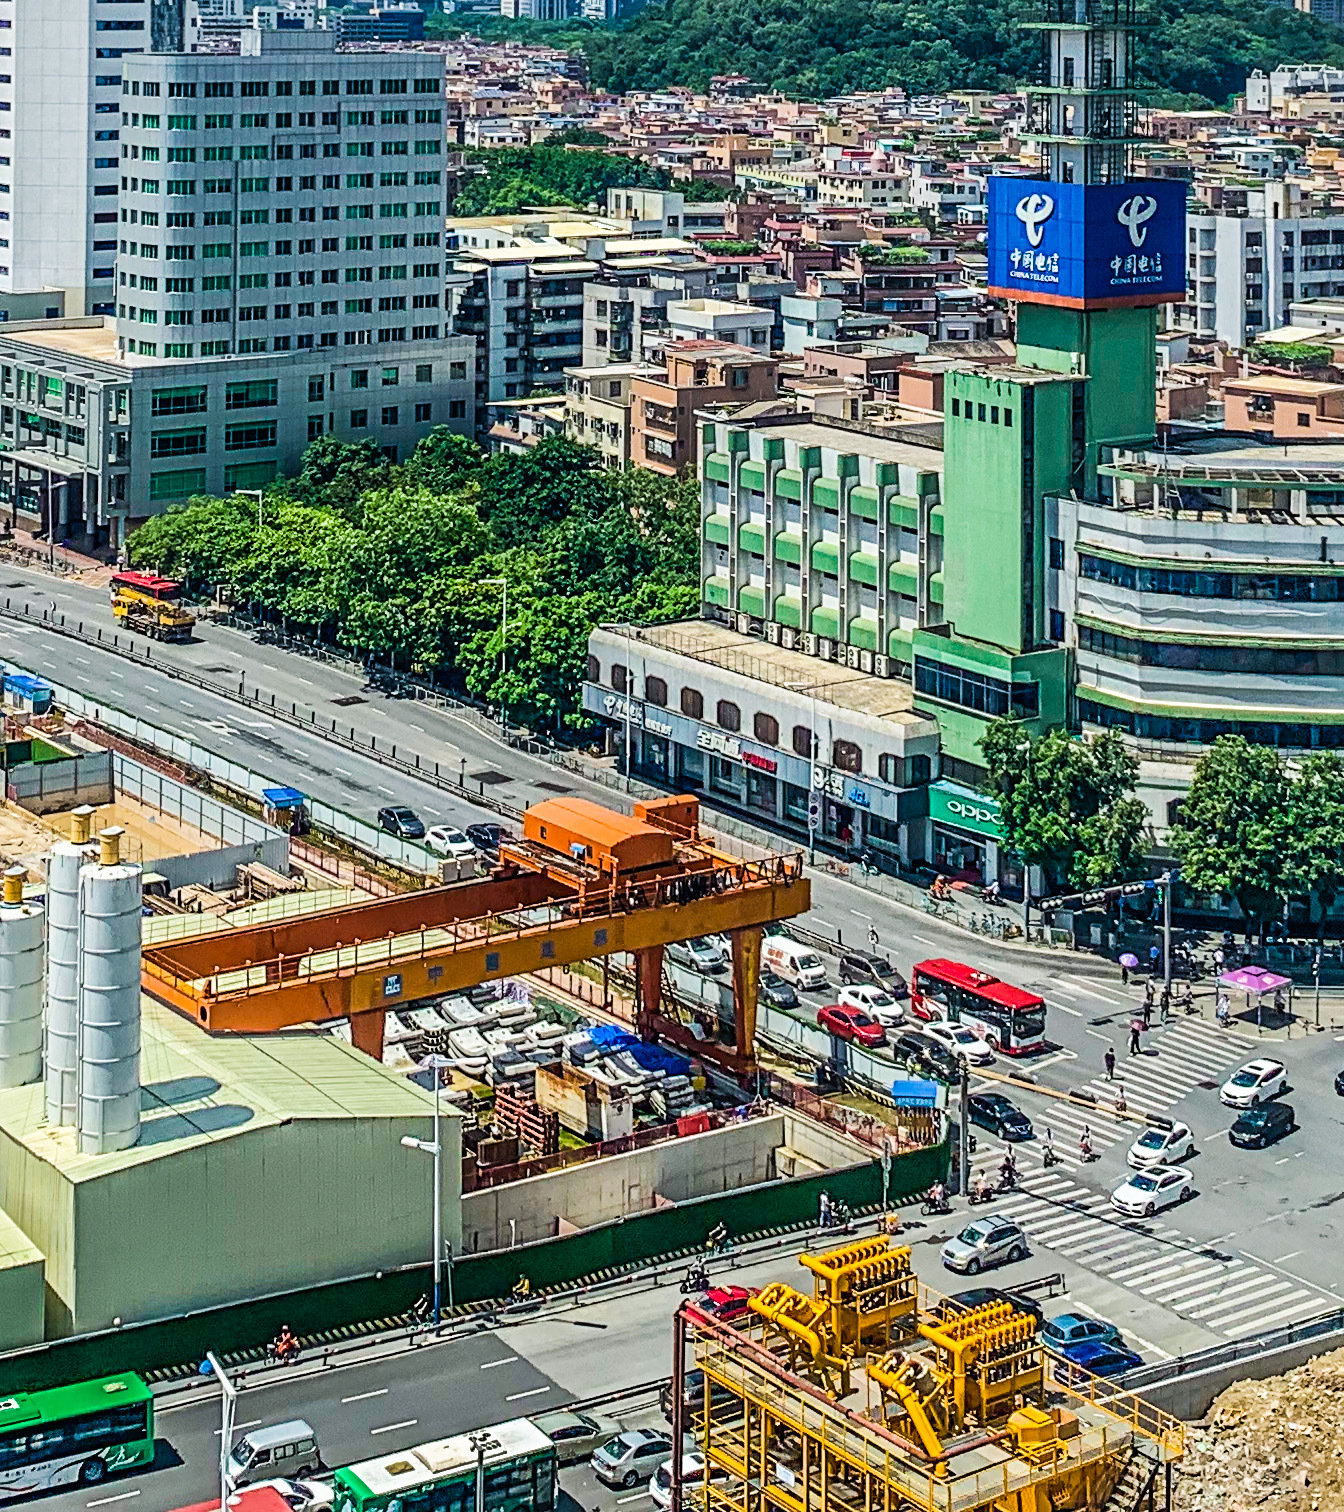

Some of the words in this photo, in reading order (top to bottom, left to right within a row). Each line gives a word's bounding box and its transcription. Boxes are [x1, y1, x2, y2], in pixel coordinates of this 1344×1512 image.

[1010, 248, 1060, 273] 中国电信
[1110, 252, 1163, 276] 中国电信
[1010, 270, 1030, 279] CHINA
[1030, 272, 1060, 283] TELECOM
[1110, 277, 1131, 285] CHINA
[1132, 275, 1163, 284] TELECOM
